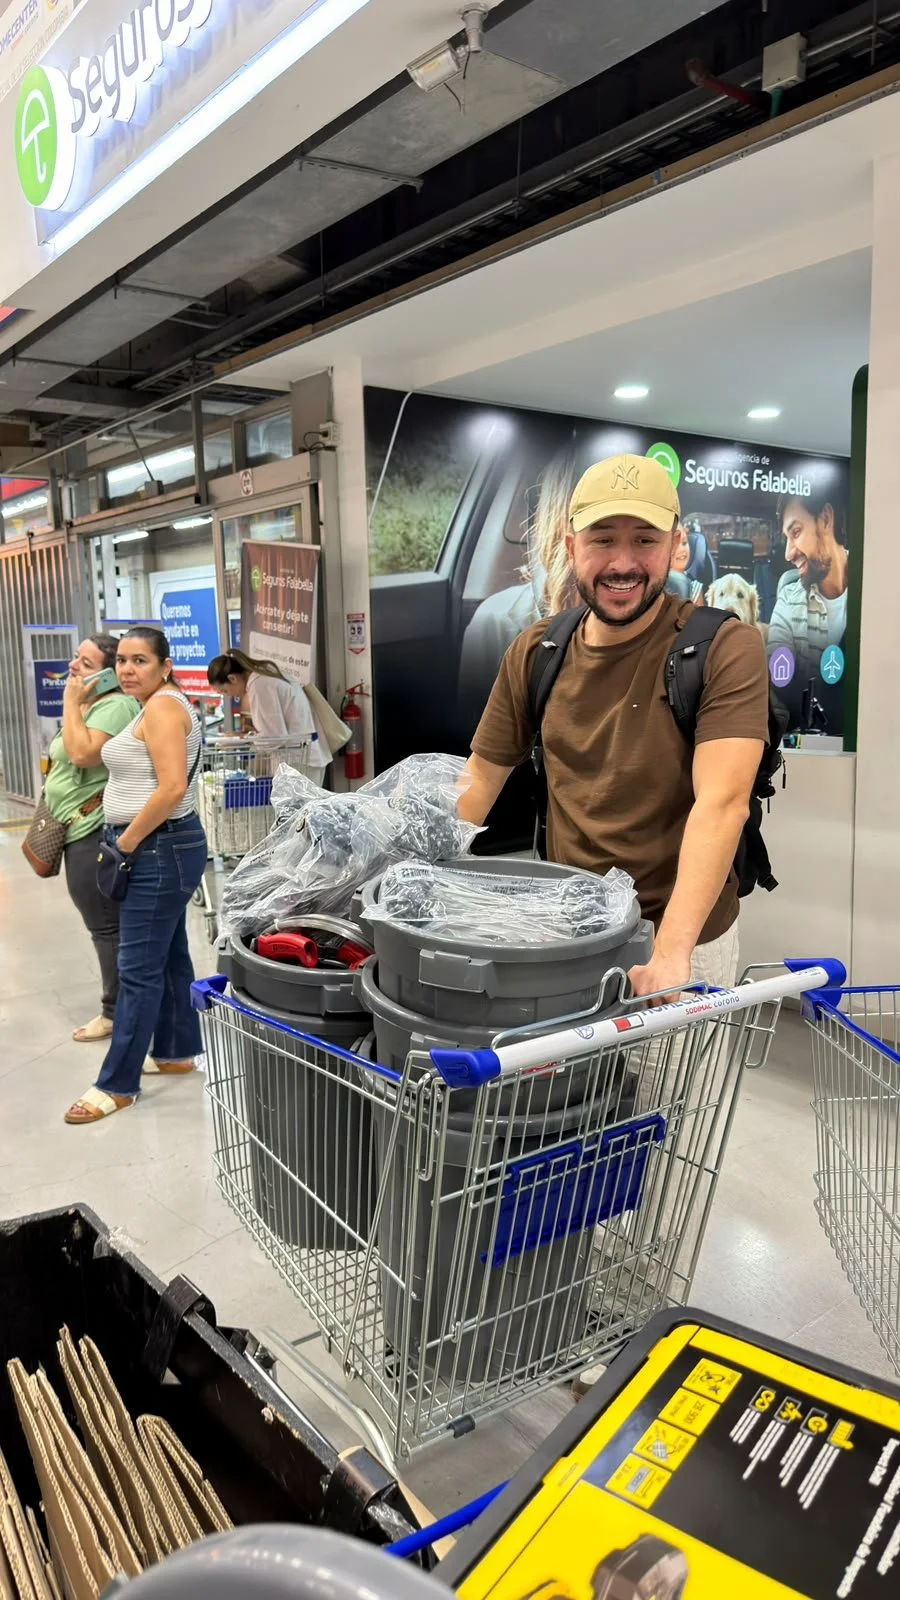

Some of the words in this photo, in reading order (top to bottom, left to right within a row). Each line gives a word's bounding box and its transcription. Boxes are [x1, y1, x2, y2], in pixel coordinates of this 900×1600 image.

[761, 455, 770, 466] de
[684, 458, 749, 492] Seguros
[752, 469, 811, 497] Falabella
[162, 602, 192, 620] Queremos
[190, 624, 199, 638] en
[176, 640, 206, 661] proyectos
[685, 1003, 712, 1016] SODIMAC
[713, 995, 740, 1008] corona
